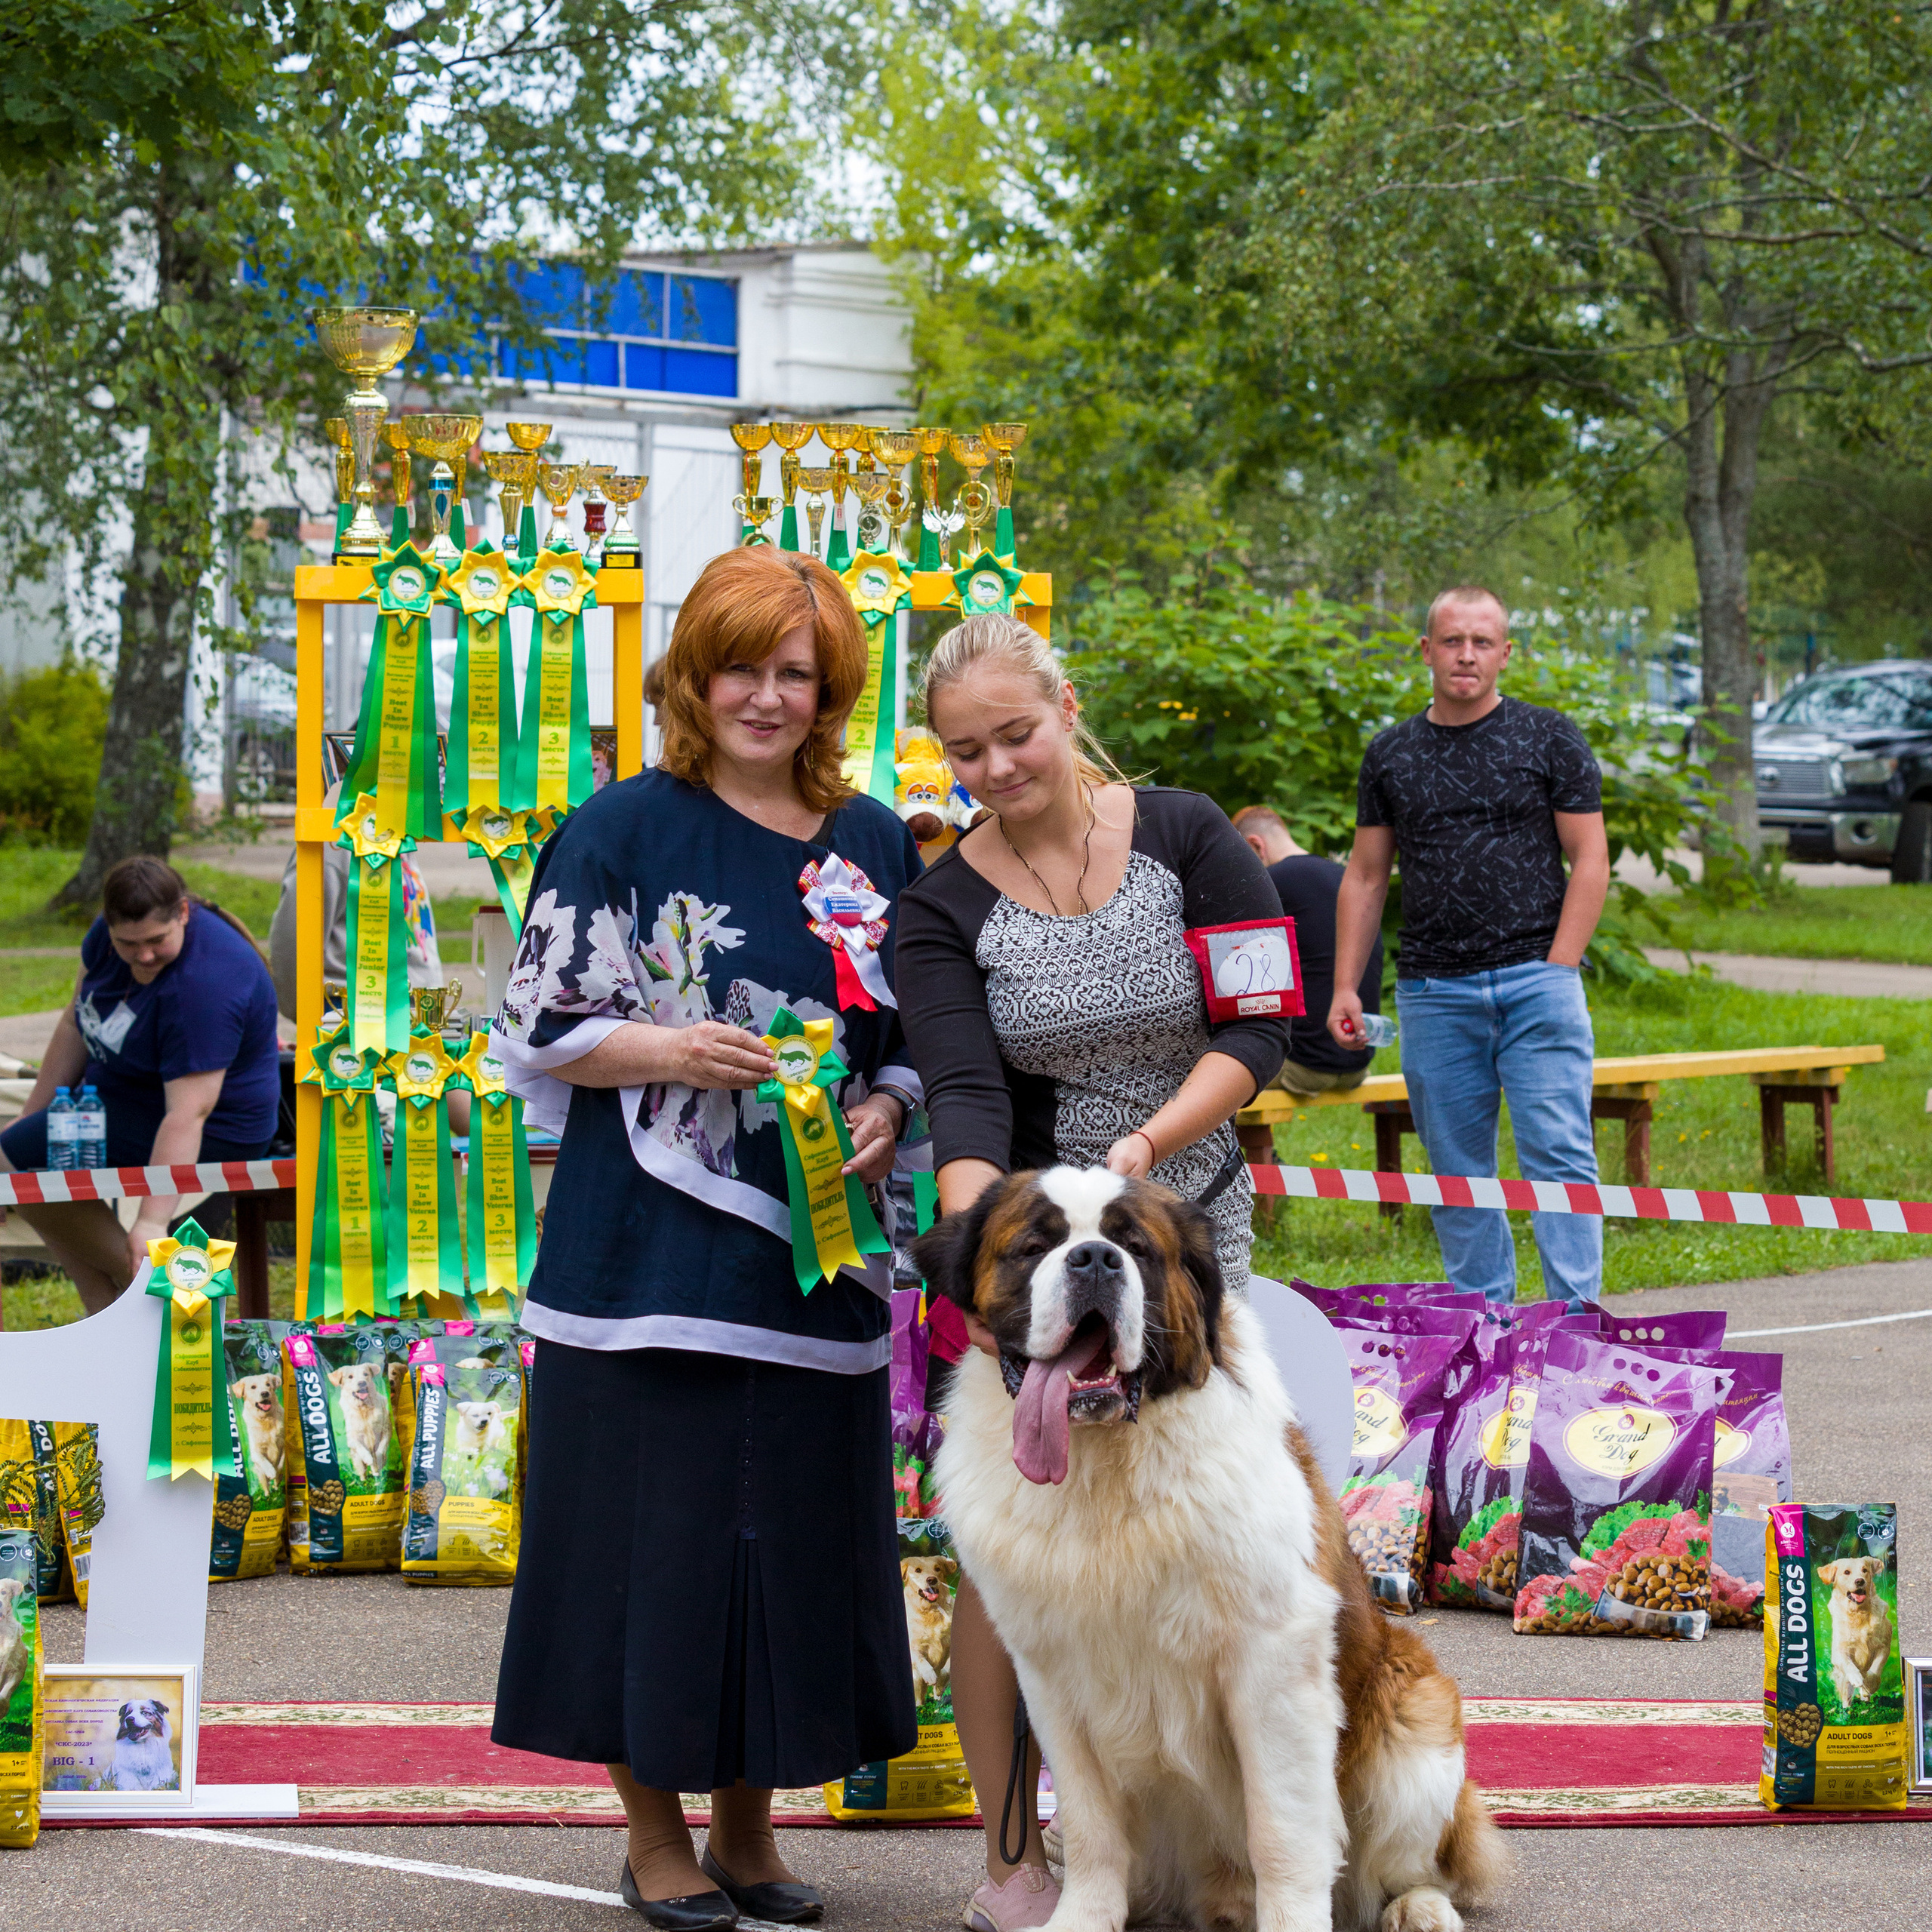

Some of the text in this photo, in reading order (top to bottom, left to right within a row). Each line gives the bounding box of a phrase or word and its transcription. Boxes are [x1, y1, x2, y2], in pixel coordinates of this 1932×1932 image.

[383, 722, 410, 731] Puppy
[541, 718, 568, 727] Puppy
[390, 735, 399, 749] 1
[478, 731, 488, 744] 2
[548, 732, 559, 744] 3
[855, 729, 866, 742] 2
[365, 975, 377, 989] 3
[811, 1191, 844, 1214] ПОБЕДИТЕЛЬ
[350, 1217, 361, 1230] 1
[417, 1220, 428, 1232] 2
[495, 1214, 506, 1226] 3
[1723, 1393, 1758, 1405] итомцам
[174, 1402, 212, 1416] ПОБЕДИТЕЛЬ
[226, 1384, 238, 1438] DO
[303, 1371, 331, 1464] ALL DOGS
[1354, 1410, 1389, 1429] and
[420, 1388, 440, 1469] ALL PUPPIES
[1592, 1423, 1651, 1443] Grand
[1599, 1442, 1639, 1466] Dog
[1786, 1564, 1807, 1632] DOGS
[1787, 1638, 1808, 1683] ALL
[53, 1757, 75, 1765] BIG
[88, 1756, 94, 1765] 1
